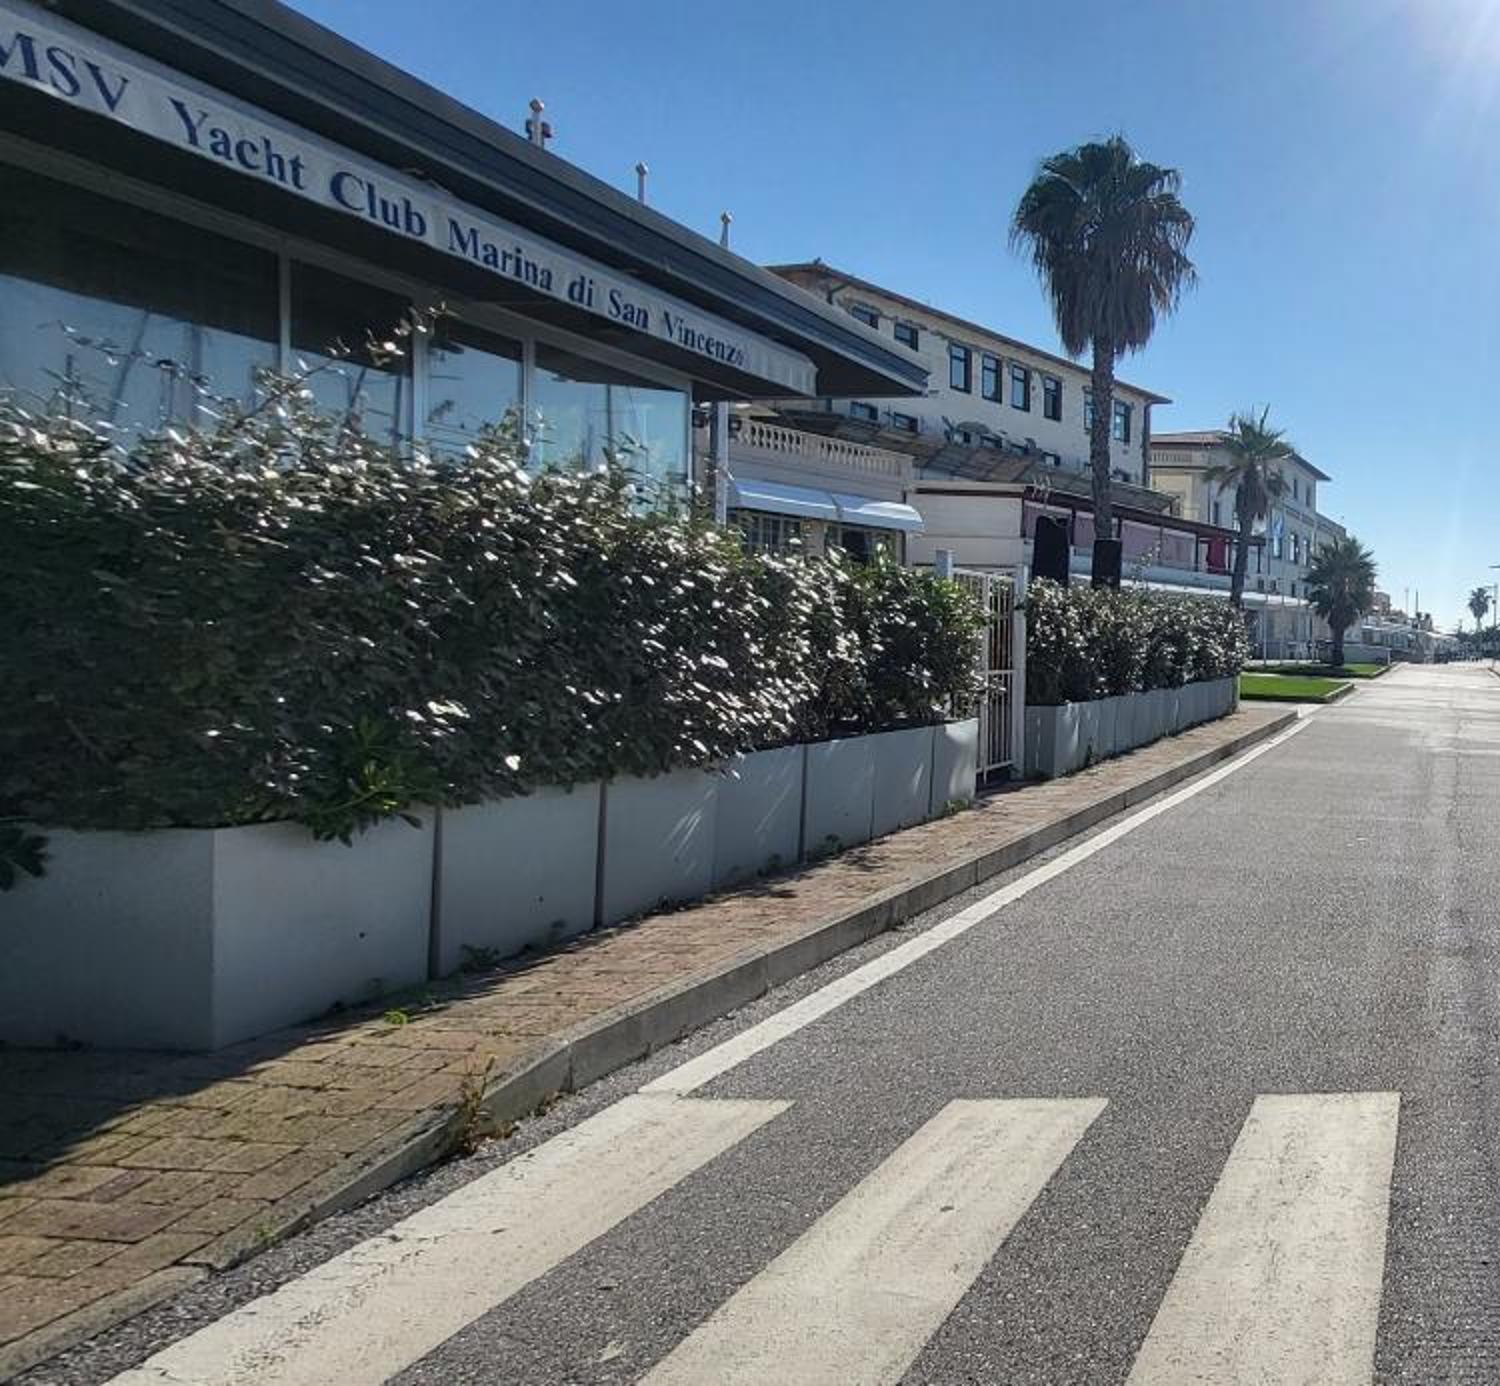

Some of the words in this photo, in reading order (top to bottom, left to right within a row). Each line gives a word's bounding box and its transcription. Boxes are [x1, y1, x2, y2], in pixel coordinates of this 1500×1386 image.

[170, 97, 305, 190] Yacht
[330, 171, 427, 237] Club
[447, 219, 553, 291] Marina
[567, 275, 594, 307] di
[608, 288, 649, 329] San
